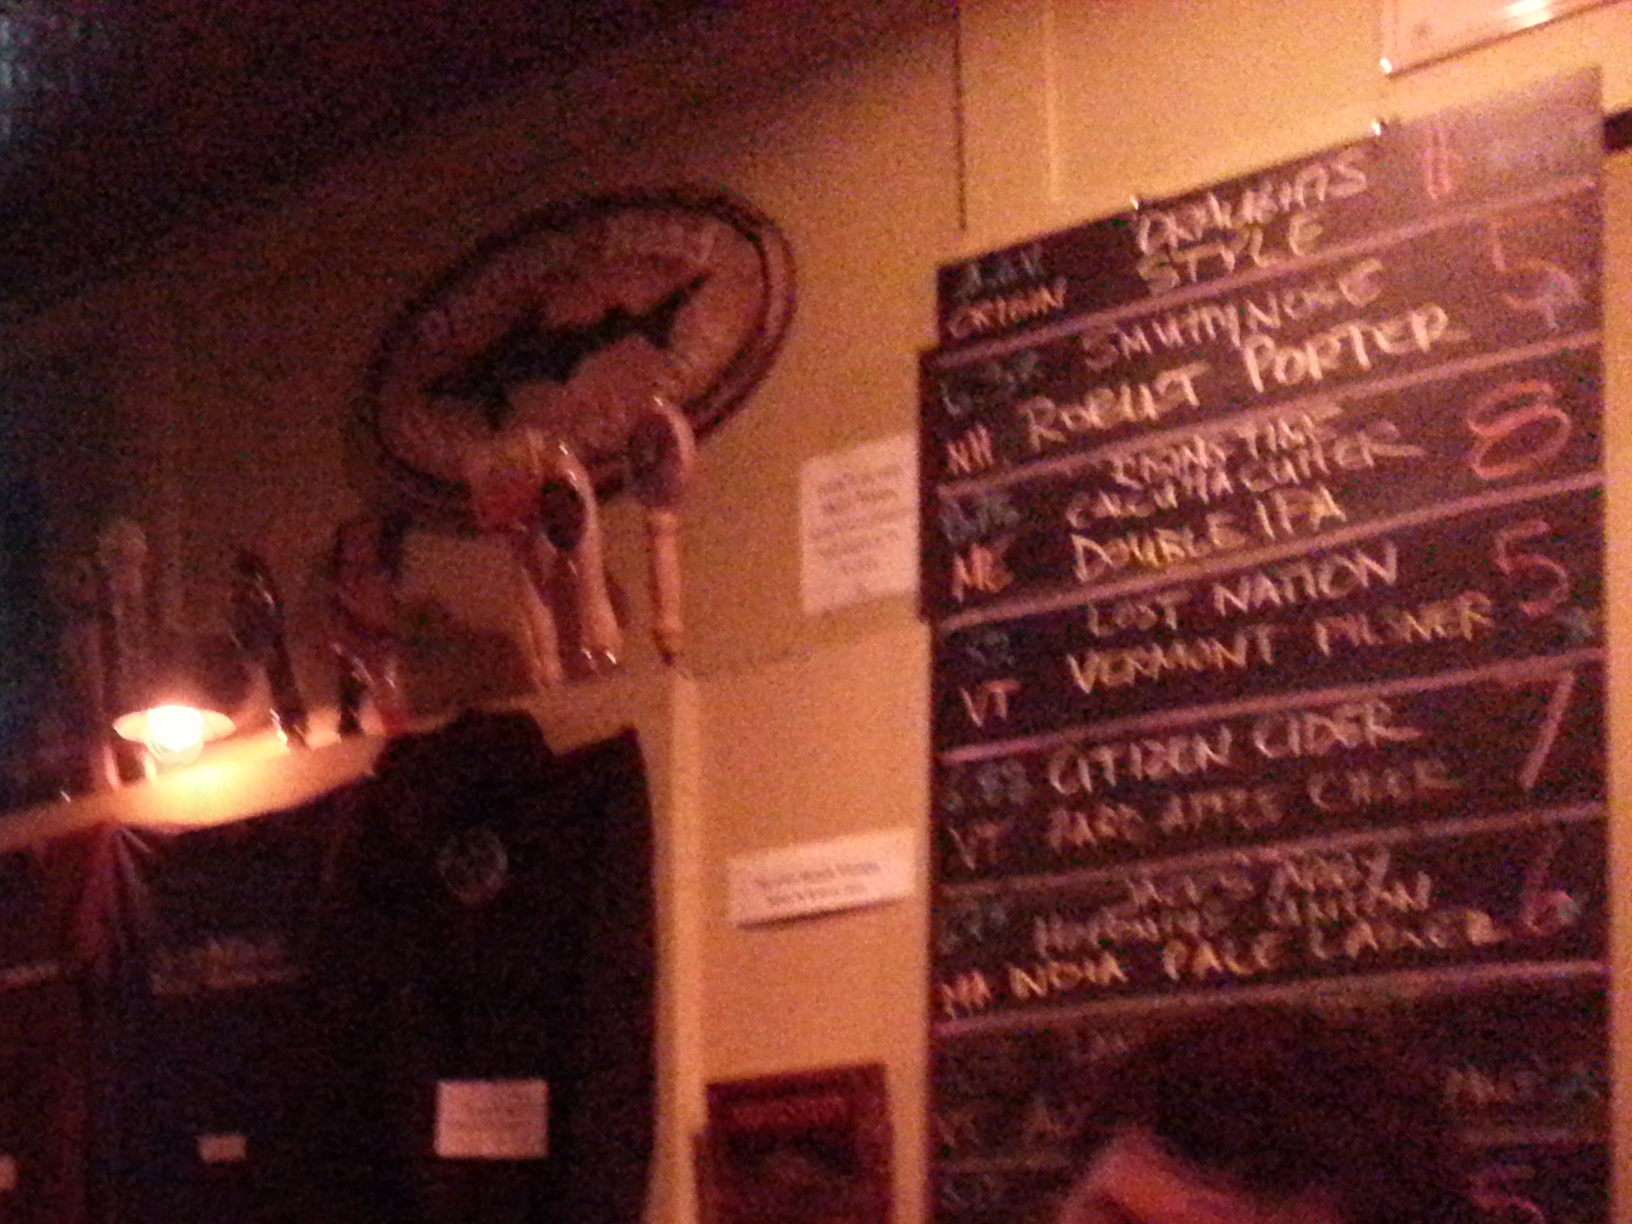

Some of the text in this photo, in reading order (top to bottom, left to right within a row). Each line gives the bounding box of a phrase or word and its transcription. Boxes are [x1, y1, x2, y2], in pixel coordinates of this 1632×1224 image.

[1081, 257, 1384, 370] SMUTTYNOSE
[1244, 304, 1468, 393] PORTER
[1468, 379, 1570, 481] 8
[1254, 484, 1347, 541] IPA
[1213, 542, 1399, 618] NATION
[1492, 520, 1568, 618] 5
[960, 678, 1022, 729] VT
[1254, 699, 1425, 762] CIDER
